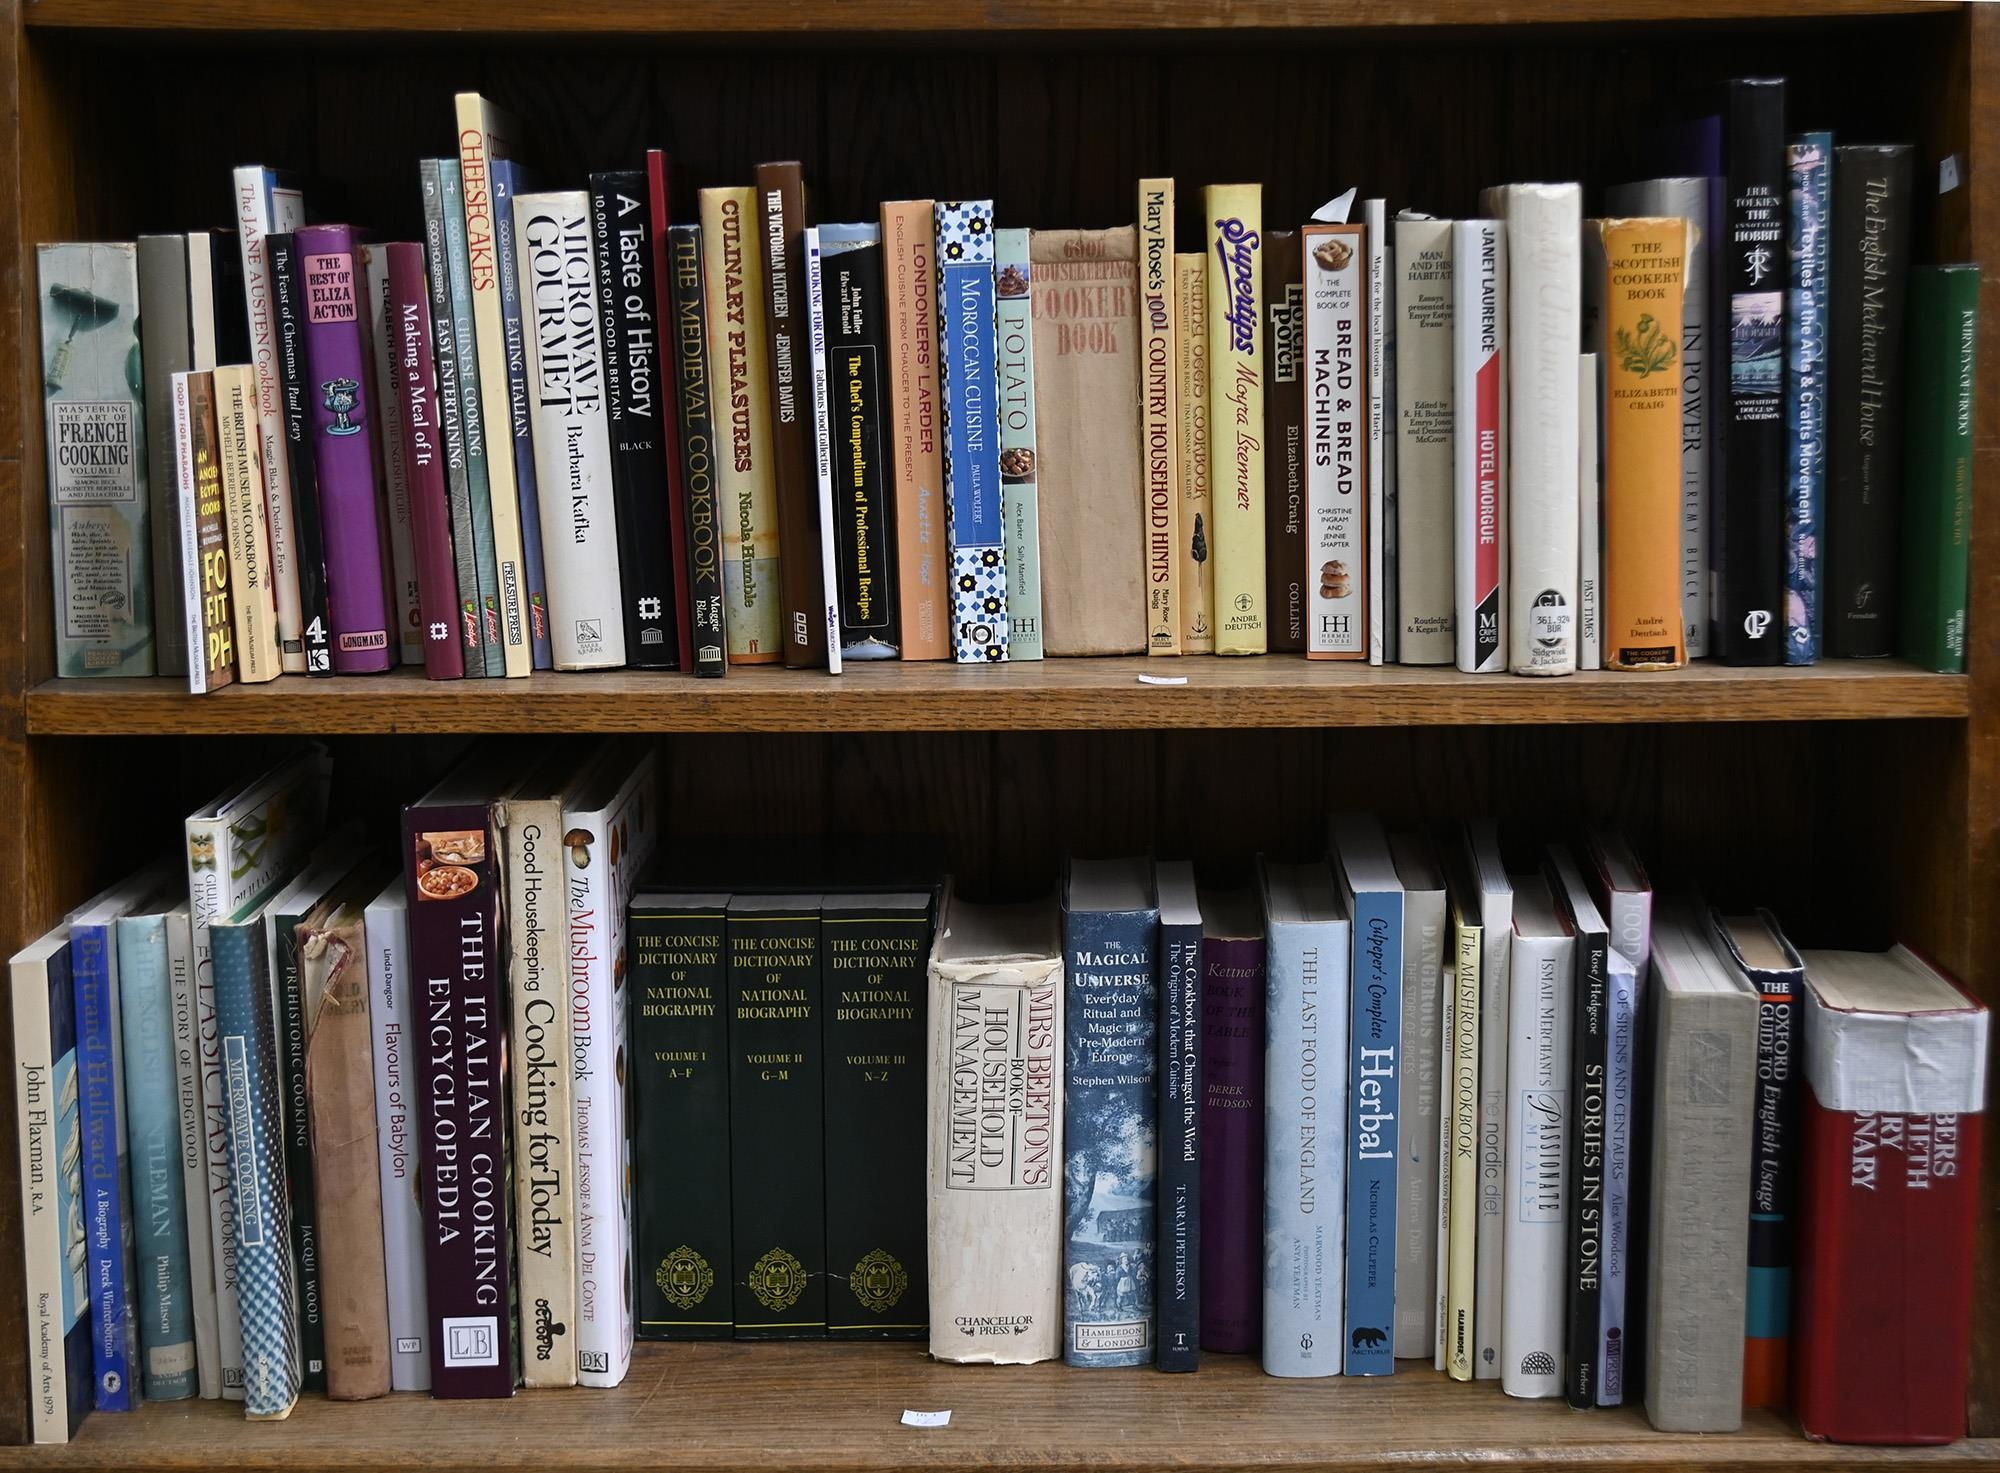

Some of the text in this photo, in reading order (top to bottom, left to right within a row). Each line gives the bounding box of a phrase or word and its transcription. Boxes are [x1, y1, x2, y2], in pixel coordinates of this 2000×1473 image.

[316, 257, 340, 270] THE
[458, 129, 494, 295] CHEESECAKES
[1612, 257, 1679, 269] SCOTTISH
[1631, 242, 1661, 253] THE
[275, 249, 296, 379] The Feast of Christmas
[308, 271, 350, 285] BEST OF
[312, 286, 351, 302] ELIZA
[313, 303, 353, 319] ACTON
[526, 215, 572, 414] GOURMET
[562, 216, 599, 414] MICROWAVE
[721, 199, 751, 472] CULINARY PLEASURES
[766, 189, 794, 422] THE VICTORIAN KITCHEN JENNIFER DAVIES
[1481, 228, 1495, 351] JANET LAURENCE
[1613, 273, 1679, 285] COOKERY
[1627, 288, 1664, 300] BOOK
[402, 303, 431, 465] Making a Meal of It
[437, 319, 461, 468] EASY ENTERTAINING
[913, 243, 933, 453] LONDONERS' LARDER
[961, 278, 982, 452] MOROCCAN CUISINE
[1004, 318, 1027, 430] POTATO
[1144, 191, 1168, 582] Mary Rose's 1001 COUNTRY HOUSEHOLD HINTS
[1315, 349, 1330, 466] MACHINES
[1336, 320, 1351, 494] BREAD & BREAD
[58, 405, 126, 414] MASTERING
[59, 422, 127, 443] FRENCH
[59, 445, 128, 465] COOKING
[176, 382, 184, 406] FOOD
[180, 441, 189, 490] PHARAOHS
[288, 386, 301, 441] Paul Levy
[677, 236, 715, 583] THE MEDIEVAL COOKBOOK
[231, 385, 257, 588] THE BRITISH MUSEUM COOKBOOK
[566, 425, 589, 543] Barbara Kafka
[848, 355, 871, 619] The Chef's Compendium of Professional Recipes
[1480, 430, 1493, 544] HOTEL MORGUE
[1016, 545, 1024, 561] Sally
[523, 824, 544, 991] Good Housekeeping
[636, 935, 719, 947] THE CONCISE
[639, 952, 717, 964] DICTIONARY
[383, 948, 392, 1009] Linda Dangoor
[643, 1004, 715, 1016] BIOGRAPHY
[647, 987, 712, 998] NATIONAL
[671, 971, 686, 980] OF
[1083, 1006, 1140, 1018] Ritual and
[1085, 991, 1139, 1006] Everyday
[1365, 918, 1388, 1038] Culpeper's Complete
[1586, 949, 1602, 1034] Rose/Hedgecoe
[173, 956, 197, 1168] THE STORY OF WEDGWOOD
[285, 966, 305, 1146] PREHISTORIC COOKING
[385, 1023, 409, 1177] Flavours of Babylon
[951, 989, 980, 1183] MANAGEMENT
[979, 1007, 1008, 1167] HOUSEHOLD
[1023, 989, 1053, 1185] MRS BEETON'S
[1072, 1074, 1150, 1087] Stephen Wilson
[1078, 1036, 1144, 1050] Pre-Modern
[1182, 941, 1196, 1161] The Cookbook that Changed the World
[1300, 947, 1317, 1214] THE LAST FOOD OF ENGLAND
[1358, 1045, 1394, 1159] Herbal
[1457, 933, 1475, 1158] The MUSHROOM COOKBOOK
[1774, 1003, 1789, 1080] OXFORD
[21, 1062, 47, 1215] John Flaxman, R.A.
[428, 977, 459, 1245] ENCYCLOPEDIA
[460, 911, 497, 1304] THE ITALIAN COOKING
[1756, 1084, 1780, 1210] English Usage
[1580, 1064, 1602, 1290] STORIES IN STONE
[39, 1292, 53, 1414] Royal Academy of Arts 1979
